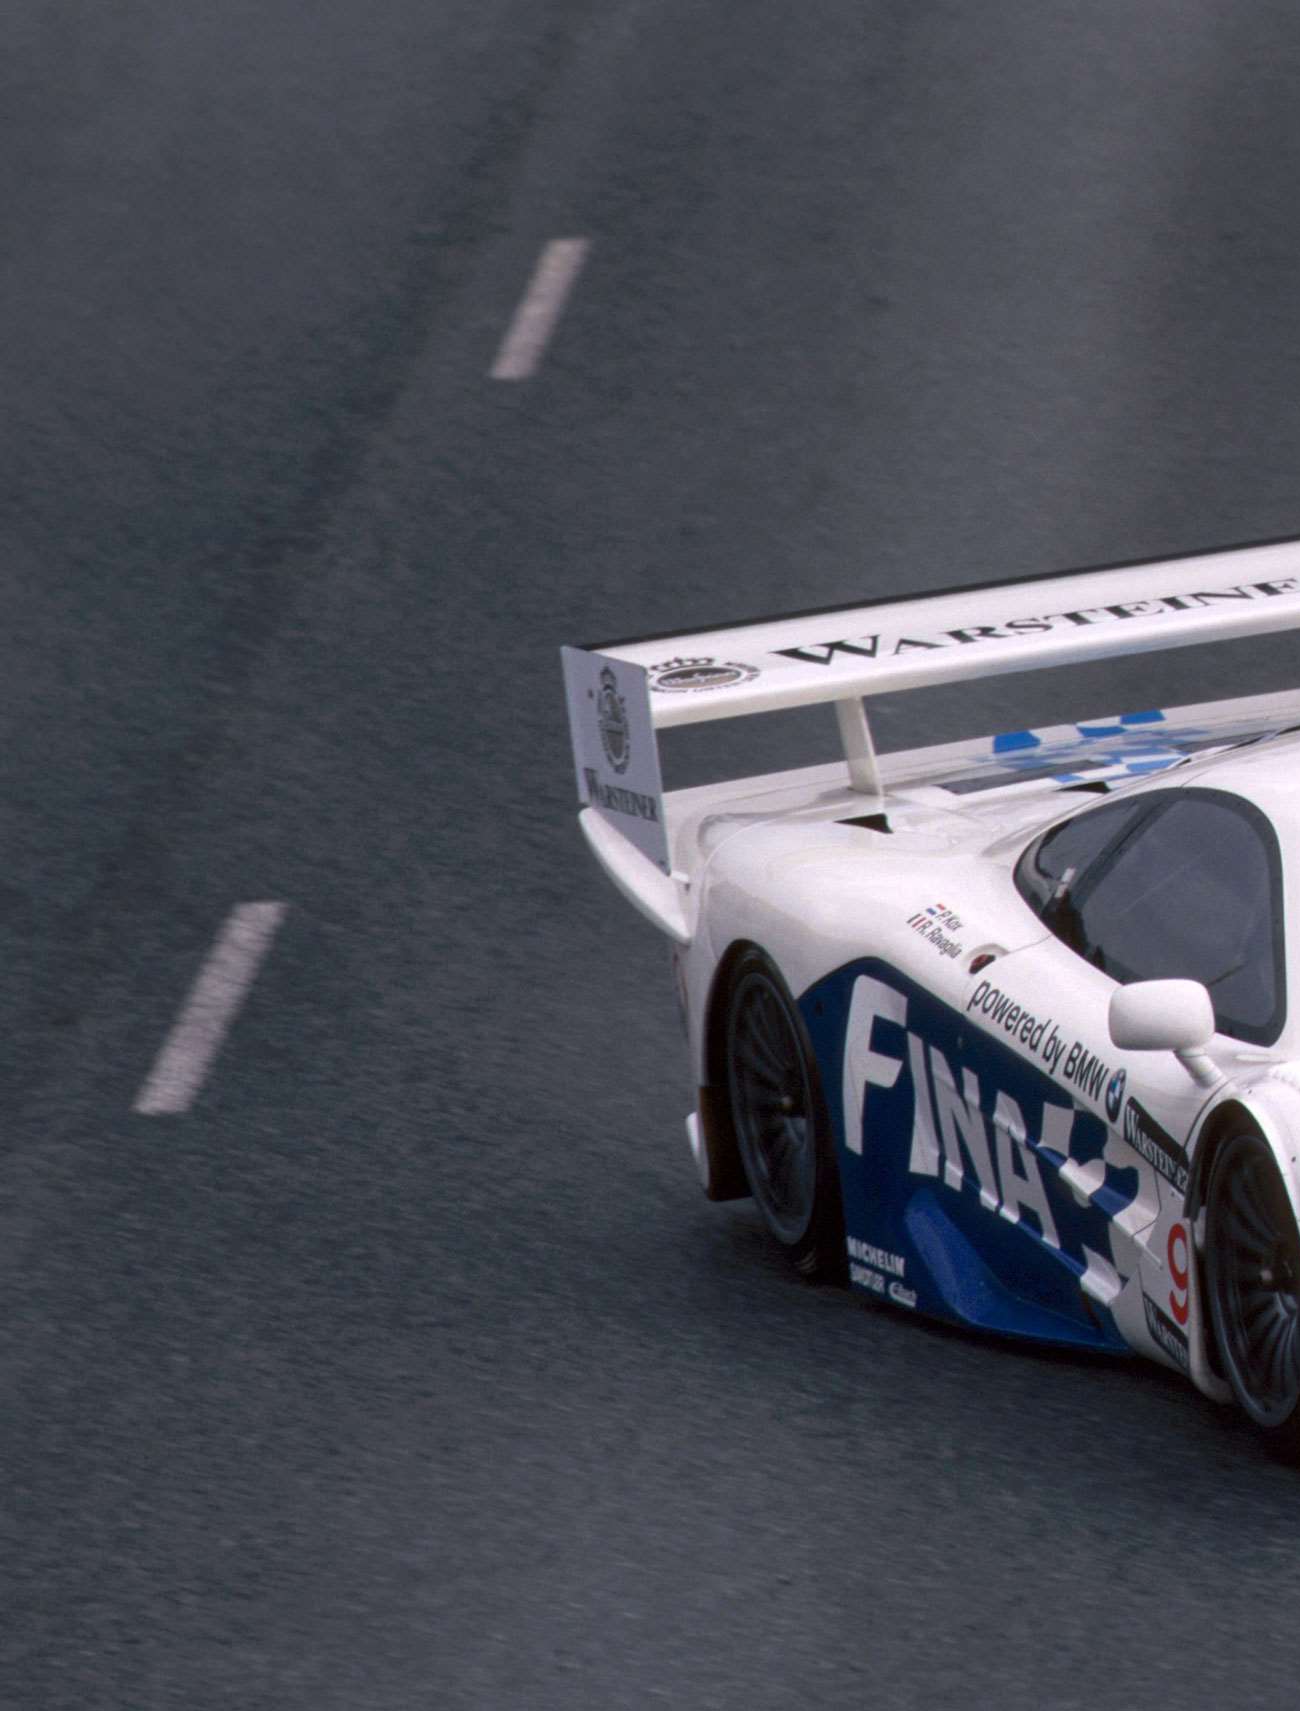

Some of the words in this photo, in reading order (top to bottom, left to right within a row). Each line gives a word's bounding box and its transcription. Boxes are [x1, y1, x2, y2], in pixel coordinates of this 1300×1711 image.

[967, 980, 1052, 1052] powered
[1042, 1025, 1067, 1075] by
[1064, 1041, 1109, 1101] BMW
[842, 974, 1061, 1250] FINA
[846, 1236, 905, 1277] MICHELIN
[1168, 1223, 1189, 1325] 9
